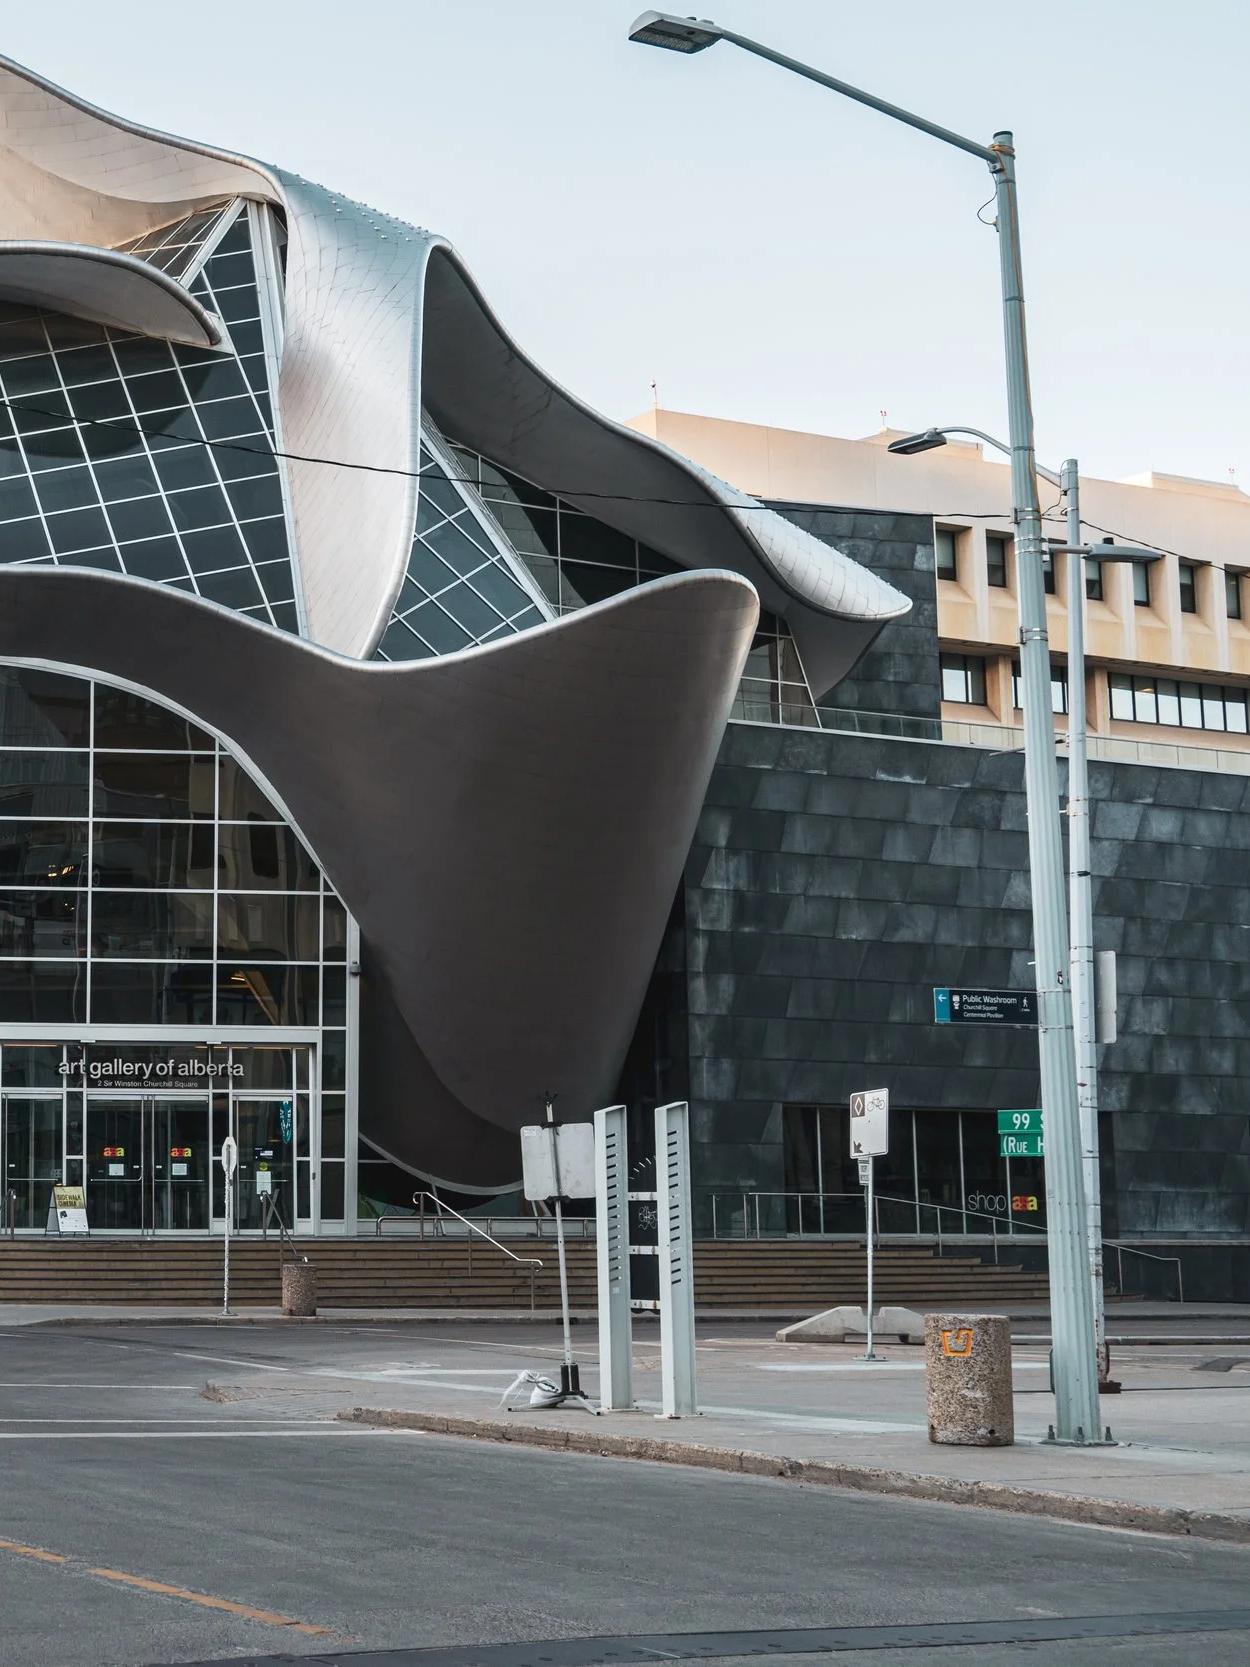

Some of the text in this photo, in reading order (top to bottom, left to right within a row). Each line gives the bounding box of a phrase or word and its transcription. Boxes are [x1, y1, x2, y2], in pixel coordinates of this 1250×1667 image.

[962, 994, 1018, 1004] Public Washroom
[58, 1058, 245, 1079] art gallery of alberta
[1012, 1113, 1030, 1130] 99
[968, 1190, 1007, 1214] shop
